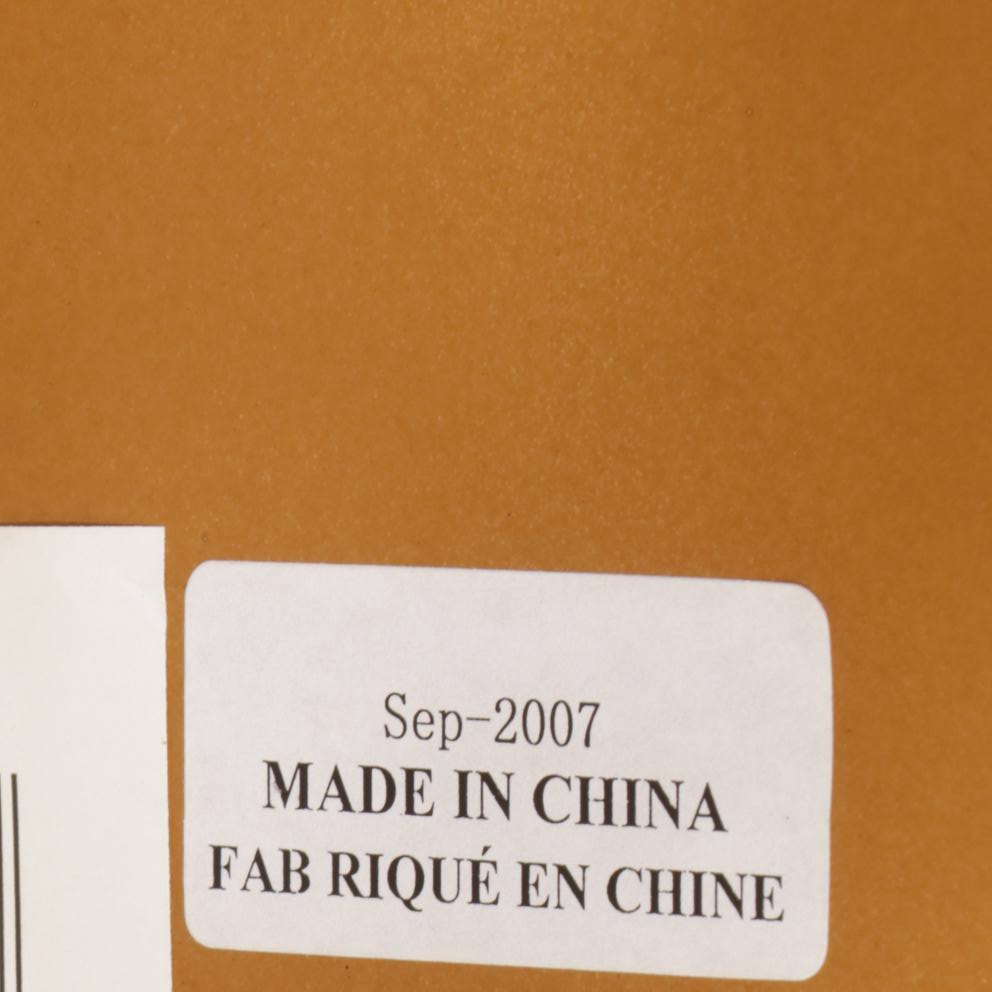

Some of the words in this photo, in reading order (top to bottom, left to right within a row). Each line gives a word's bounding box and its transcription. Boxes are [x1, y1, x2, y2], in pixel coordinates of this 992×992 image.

[383, 691, 601, 751] Sep-2007
[262, 759, 435, 818] MADE
[454, 769, 516, 822] IN
[532, 774, 729, 833] CHINA
[517, 861, 591, 911] EN
[606, 866, 785, 923] CHINE
